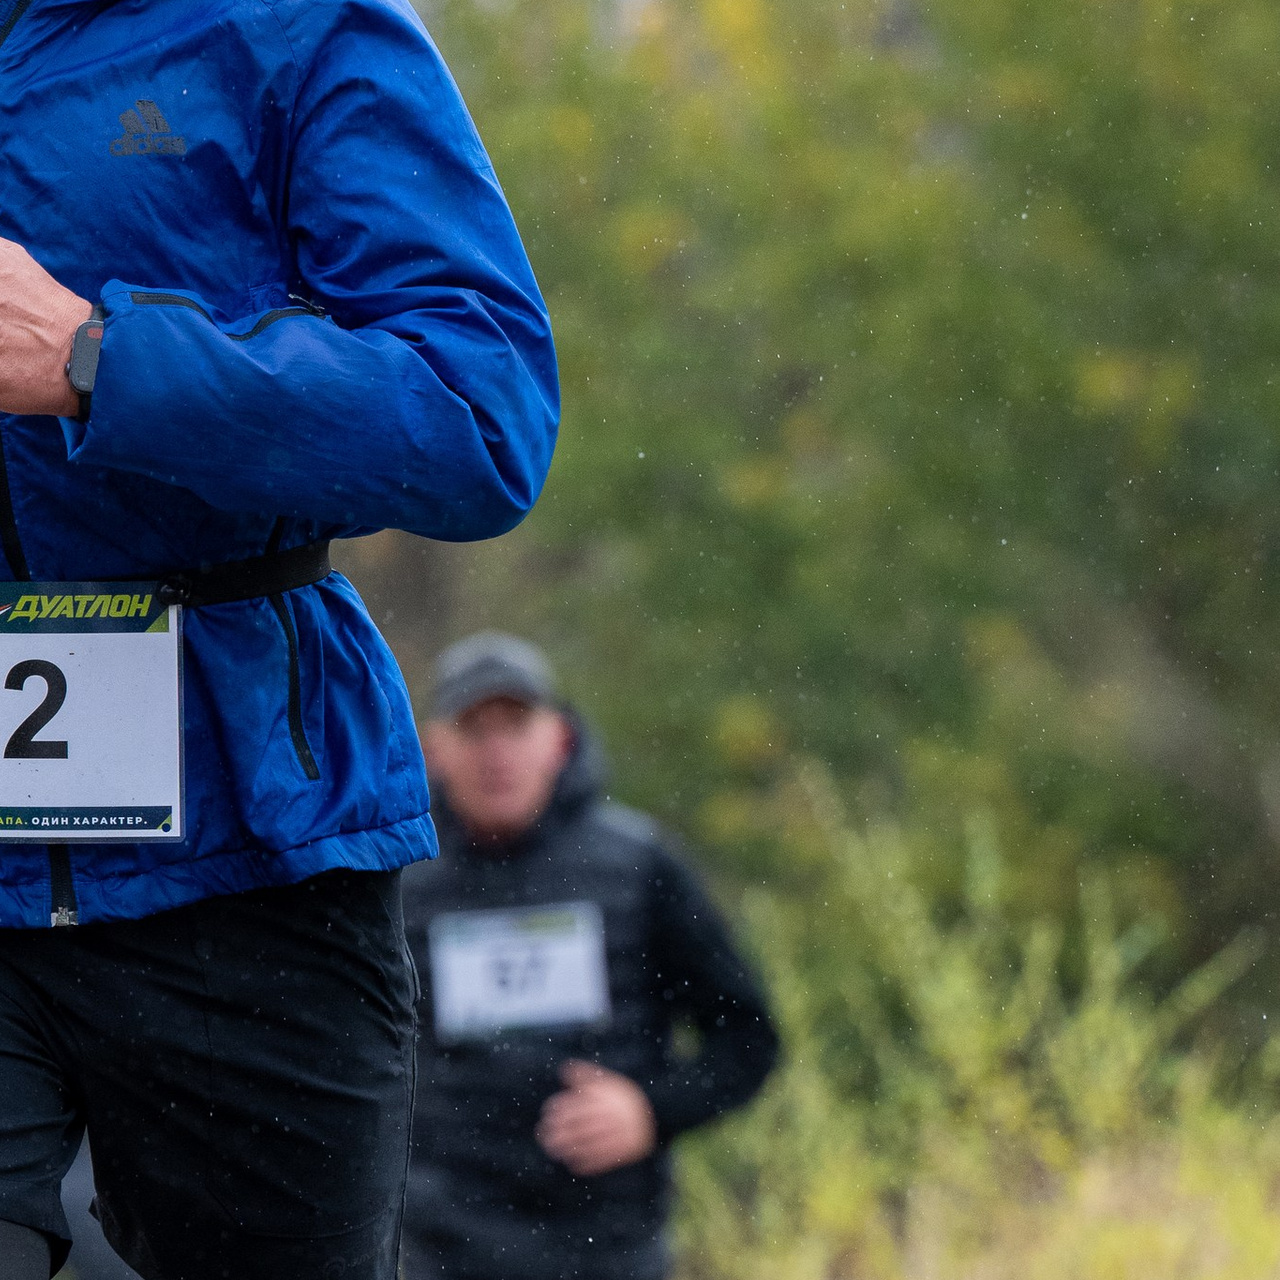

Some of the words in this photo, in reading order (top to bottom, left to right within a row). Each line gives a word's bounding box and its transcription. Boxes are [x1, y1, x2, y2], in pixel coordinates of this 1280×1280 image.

[8, 594, 153, 622] ДУАТЛОН
[31, 817, 69, 826] ОДИН
[73, 817, 148, 826] ХАРАКТЕР.
